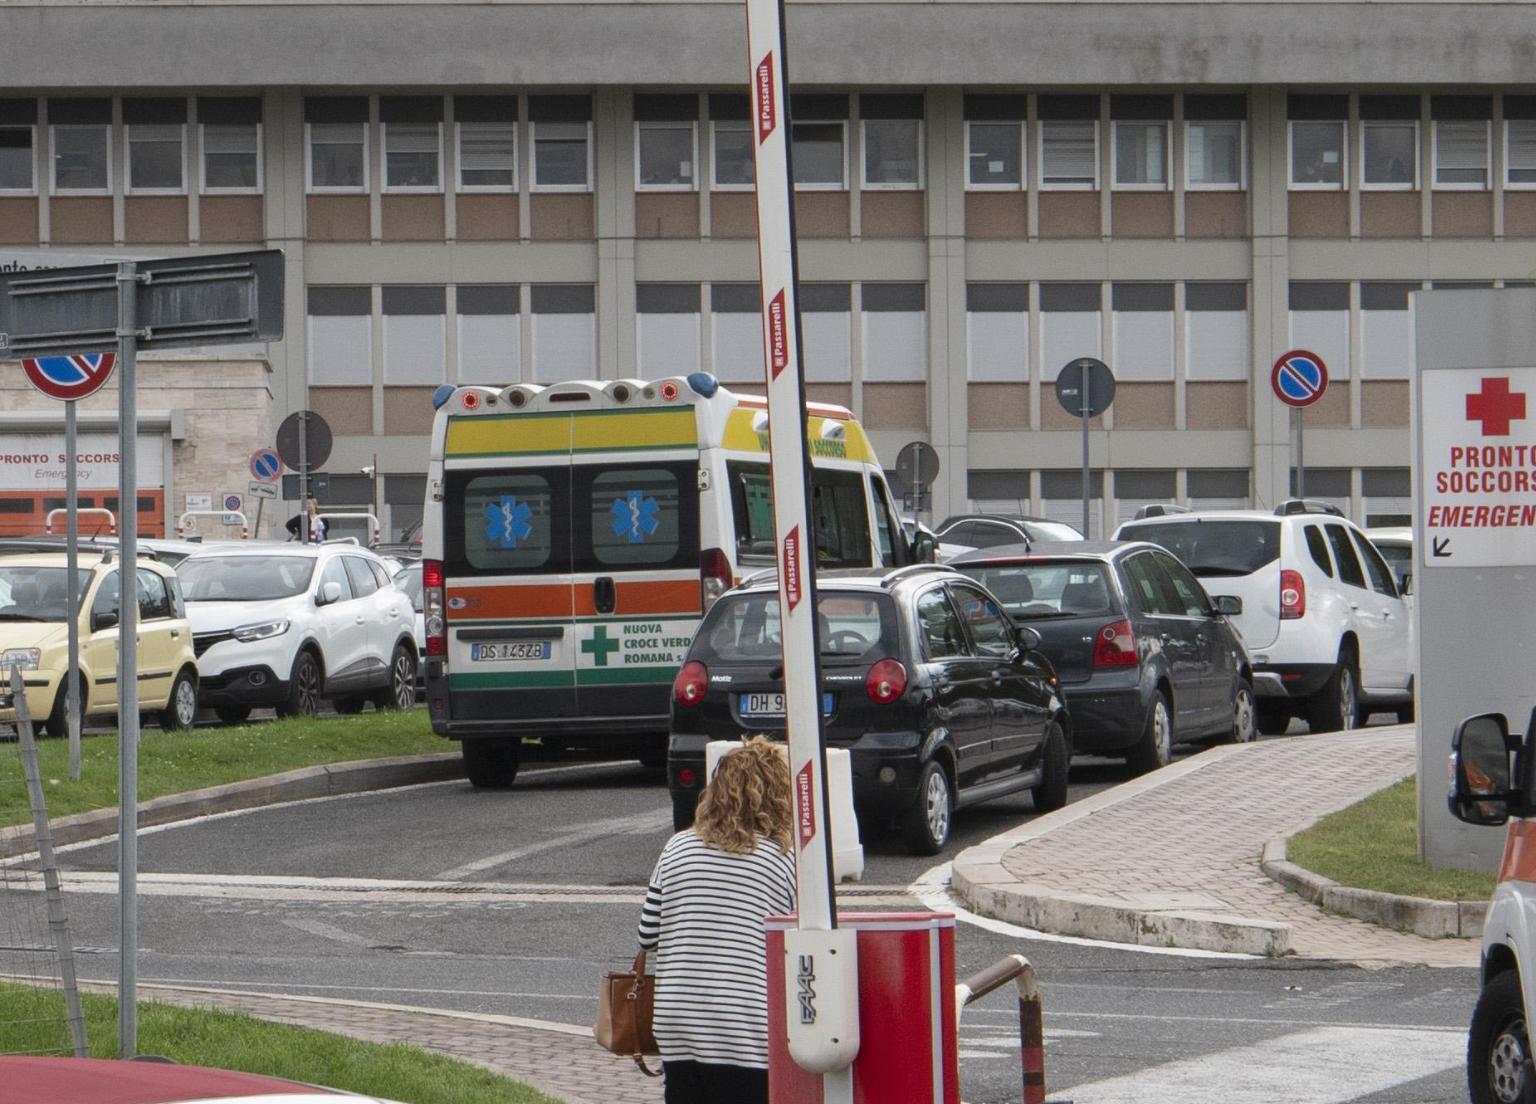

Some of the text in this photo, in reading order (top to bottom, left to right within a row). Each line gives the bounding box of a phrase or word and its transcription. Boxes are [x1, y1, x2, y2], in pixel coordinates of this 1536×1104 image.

[759, 66, 770, 119] Passarelli
[772, 303, 784, 356] Passarelli
[35, 469, 92, 480] Emergncy
[785, 538, 797, 592] Passarelli
[623, 624, 663, 634] NUOVA
[624, 637, 693, 649] CROCE VERD
[480, 644, 497, 659] DS
[624, 652, 674, 664] ROMANA
[750, 695, 769, 711] DH
[799, 773, 811, 826] Passarelli
[797, 955, 816, 1024] FAAC
